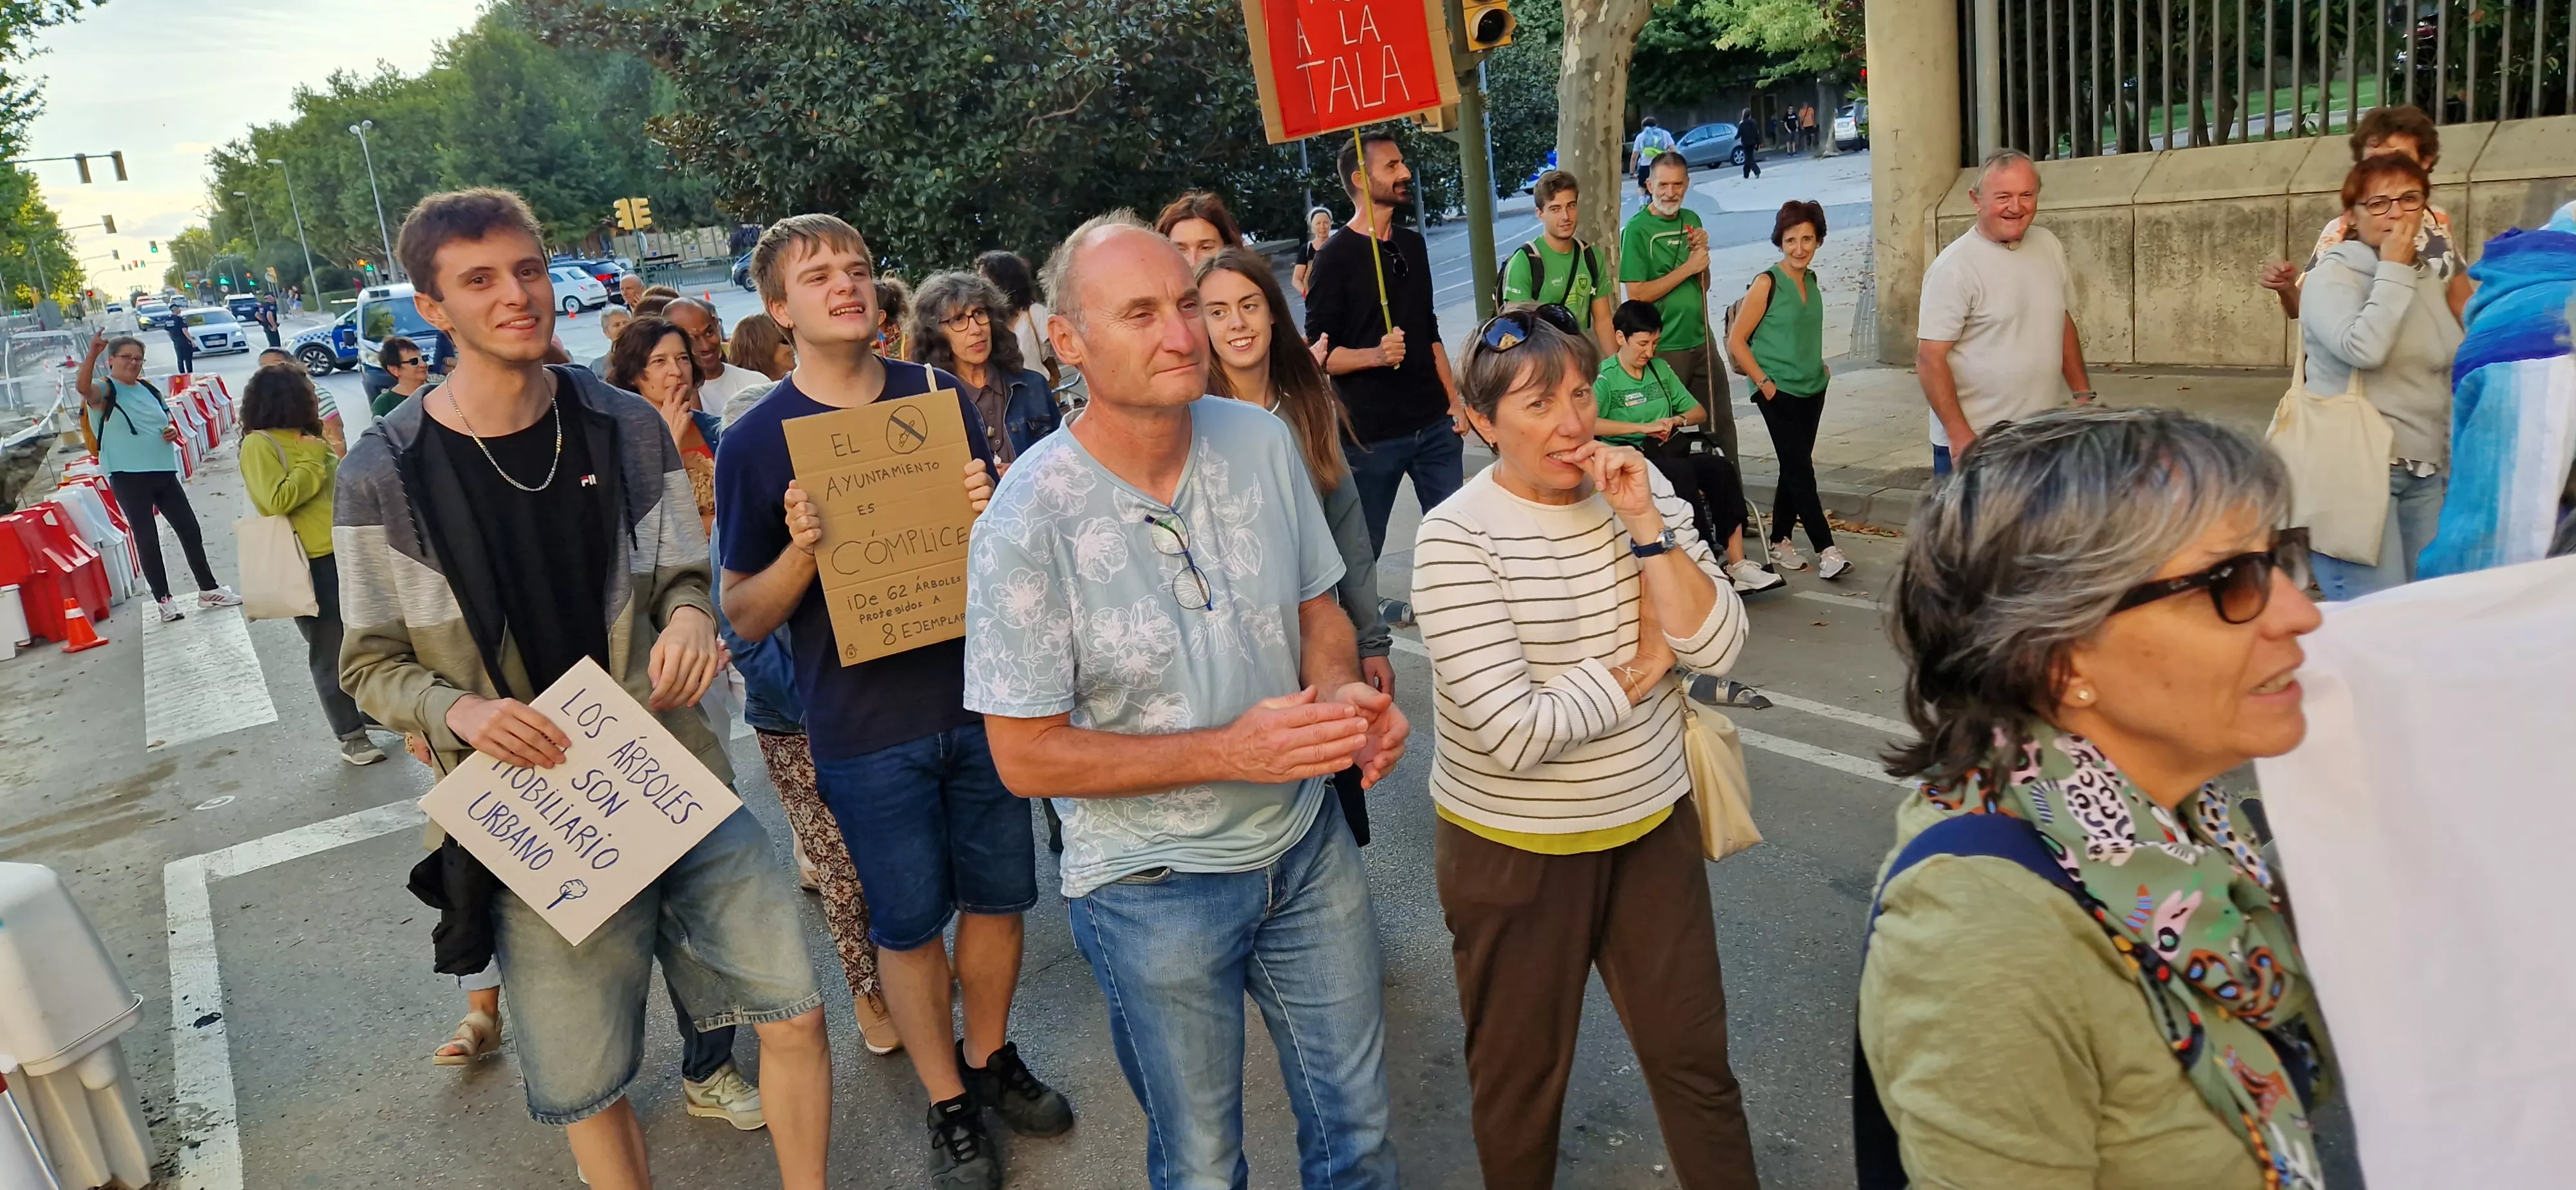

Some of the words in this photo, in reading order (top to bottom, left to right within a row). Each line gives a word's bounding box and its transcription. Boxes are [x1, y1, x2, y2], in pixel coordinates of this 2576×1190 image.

[1297, 18, 1312, 58] A
[1339, 5, 1381, 46] LA
[1296, 44, 1410, 114] TALA
[830, 433, 861, 457] EL
[857, 503, 875, 516] ES
[887, 584, 907, 600] 62
[933, 595, 941, 604] A
[883, 623, 896, 646] 8
[560, 688, 618, 739] LOS
[607, 736, 703, 825] ÁRBOLES
[571, 769, 629, 818] SON
[468, 791, 554, 871] URBANO
